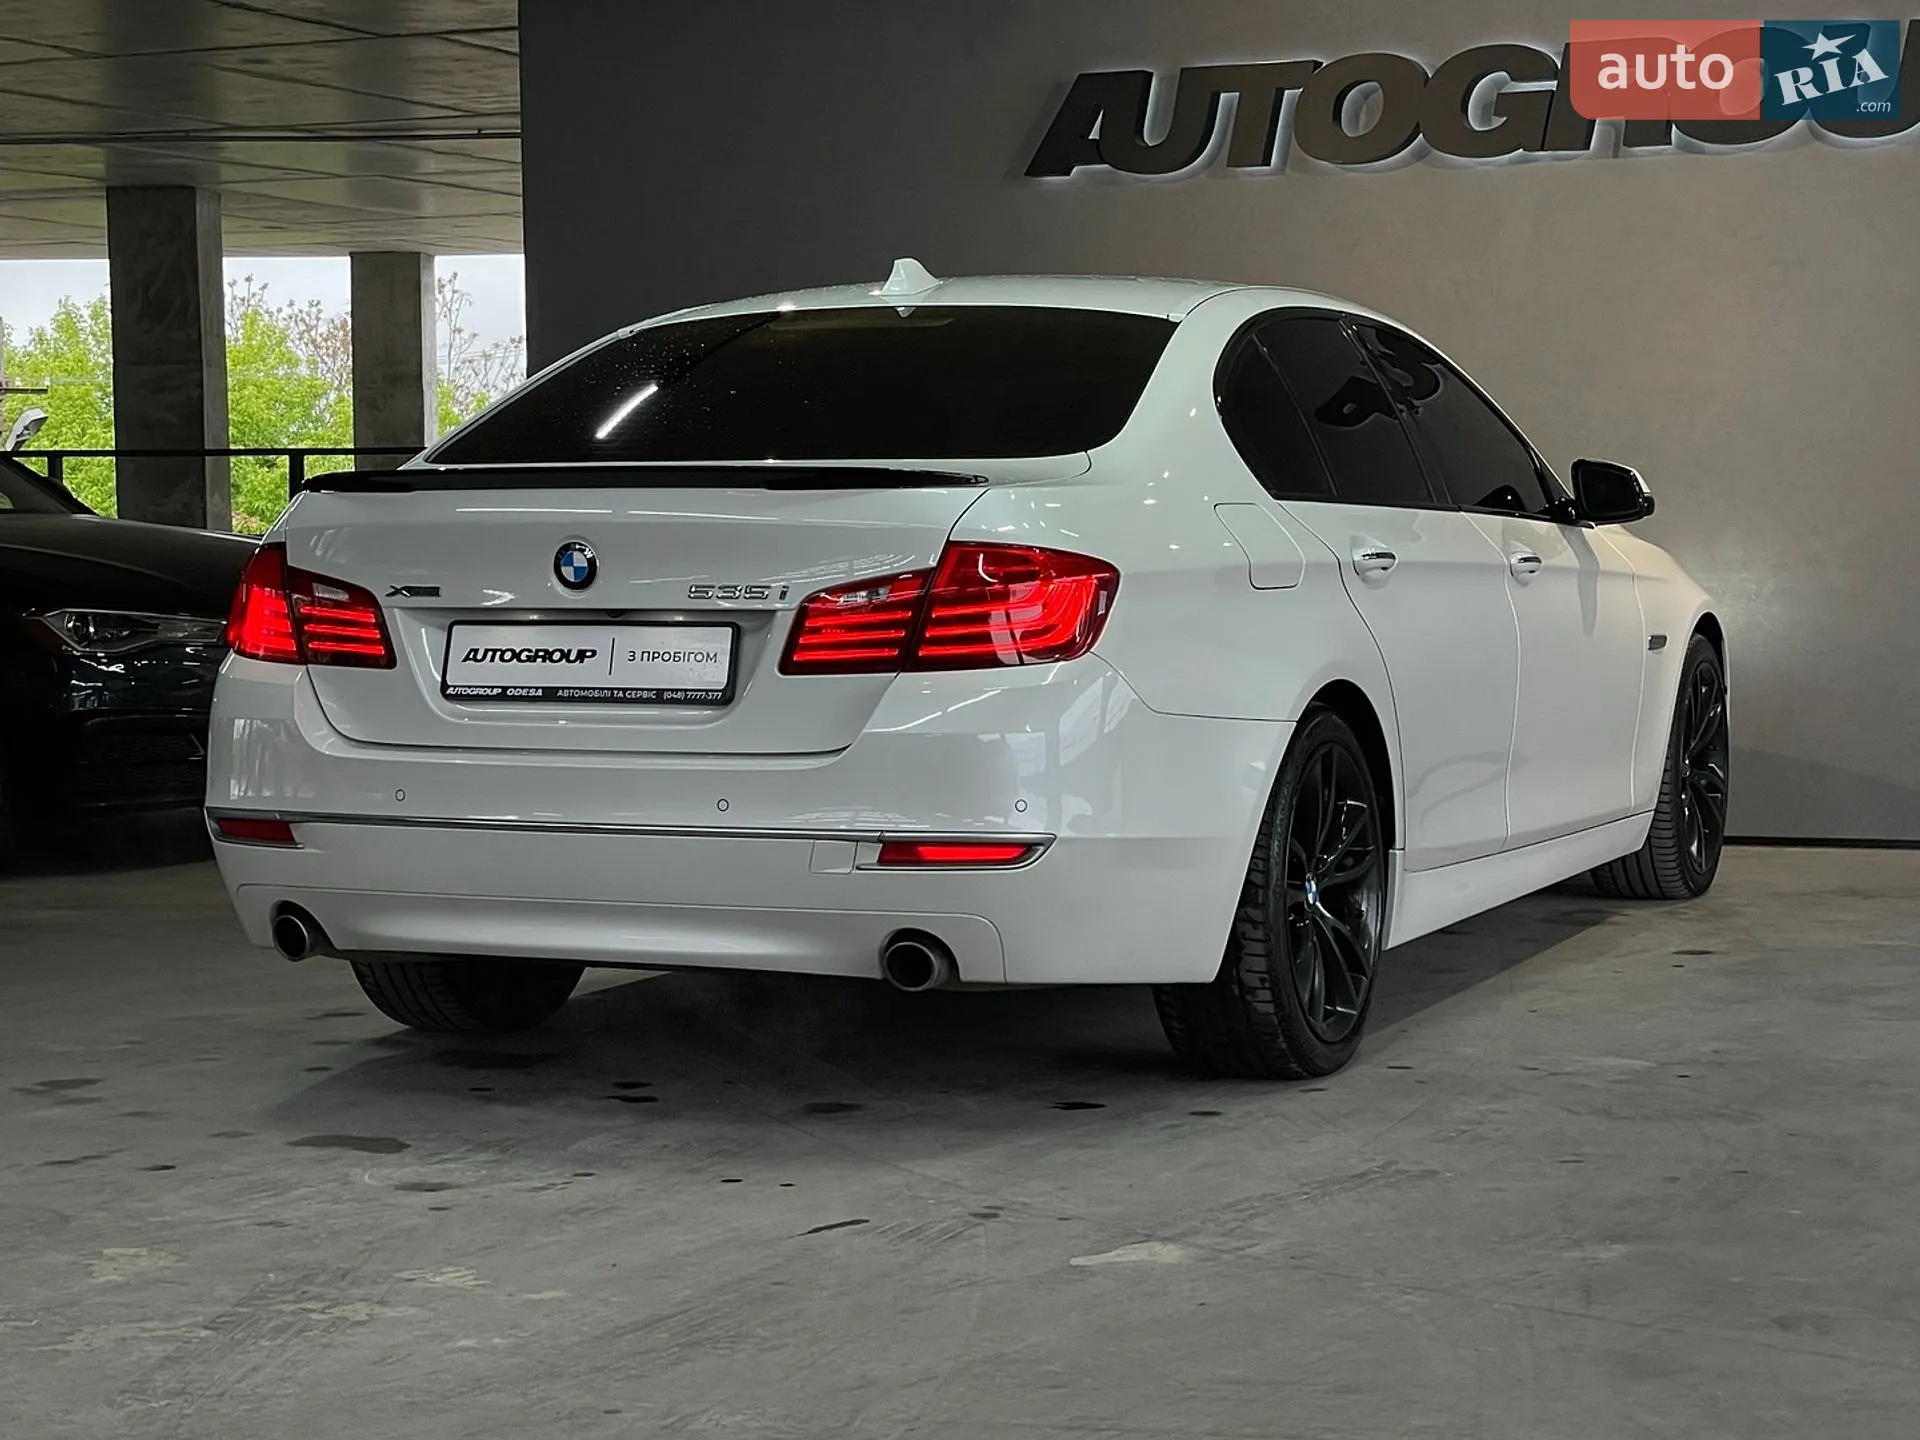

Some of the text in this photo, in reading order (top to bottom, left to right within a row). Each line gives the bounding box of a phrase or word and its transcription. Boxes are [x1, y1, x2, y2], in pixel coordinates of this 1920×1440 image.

[461, 648, 597, 664] AUTOGROUP
[627, 650, 718, 663] З ПРОБІГОМ
[446, 687, 542, 696] AUTOGROUP ODESA
[557, 689, 657, 699] АВТОМОБІЛІ ТА СЕРВІС
